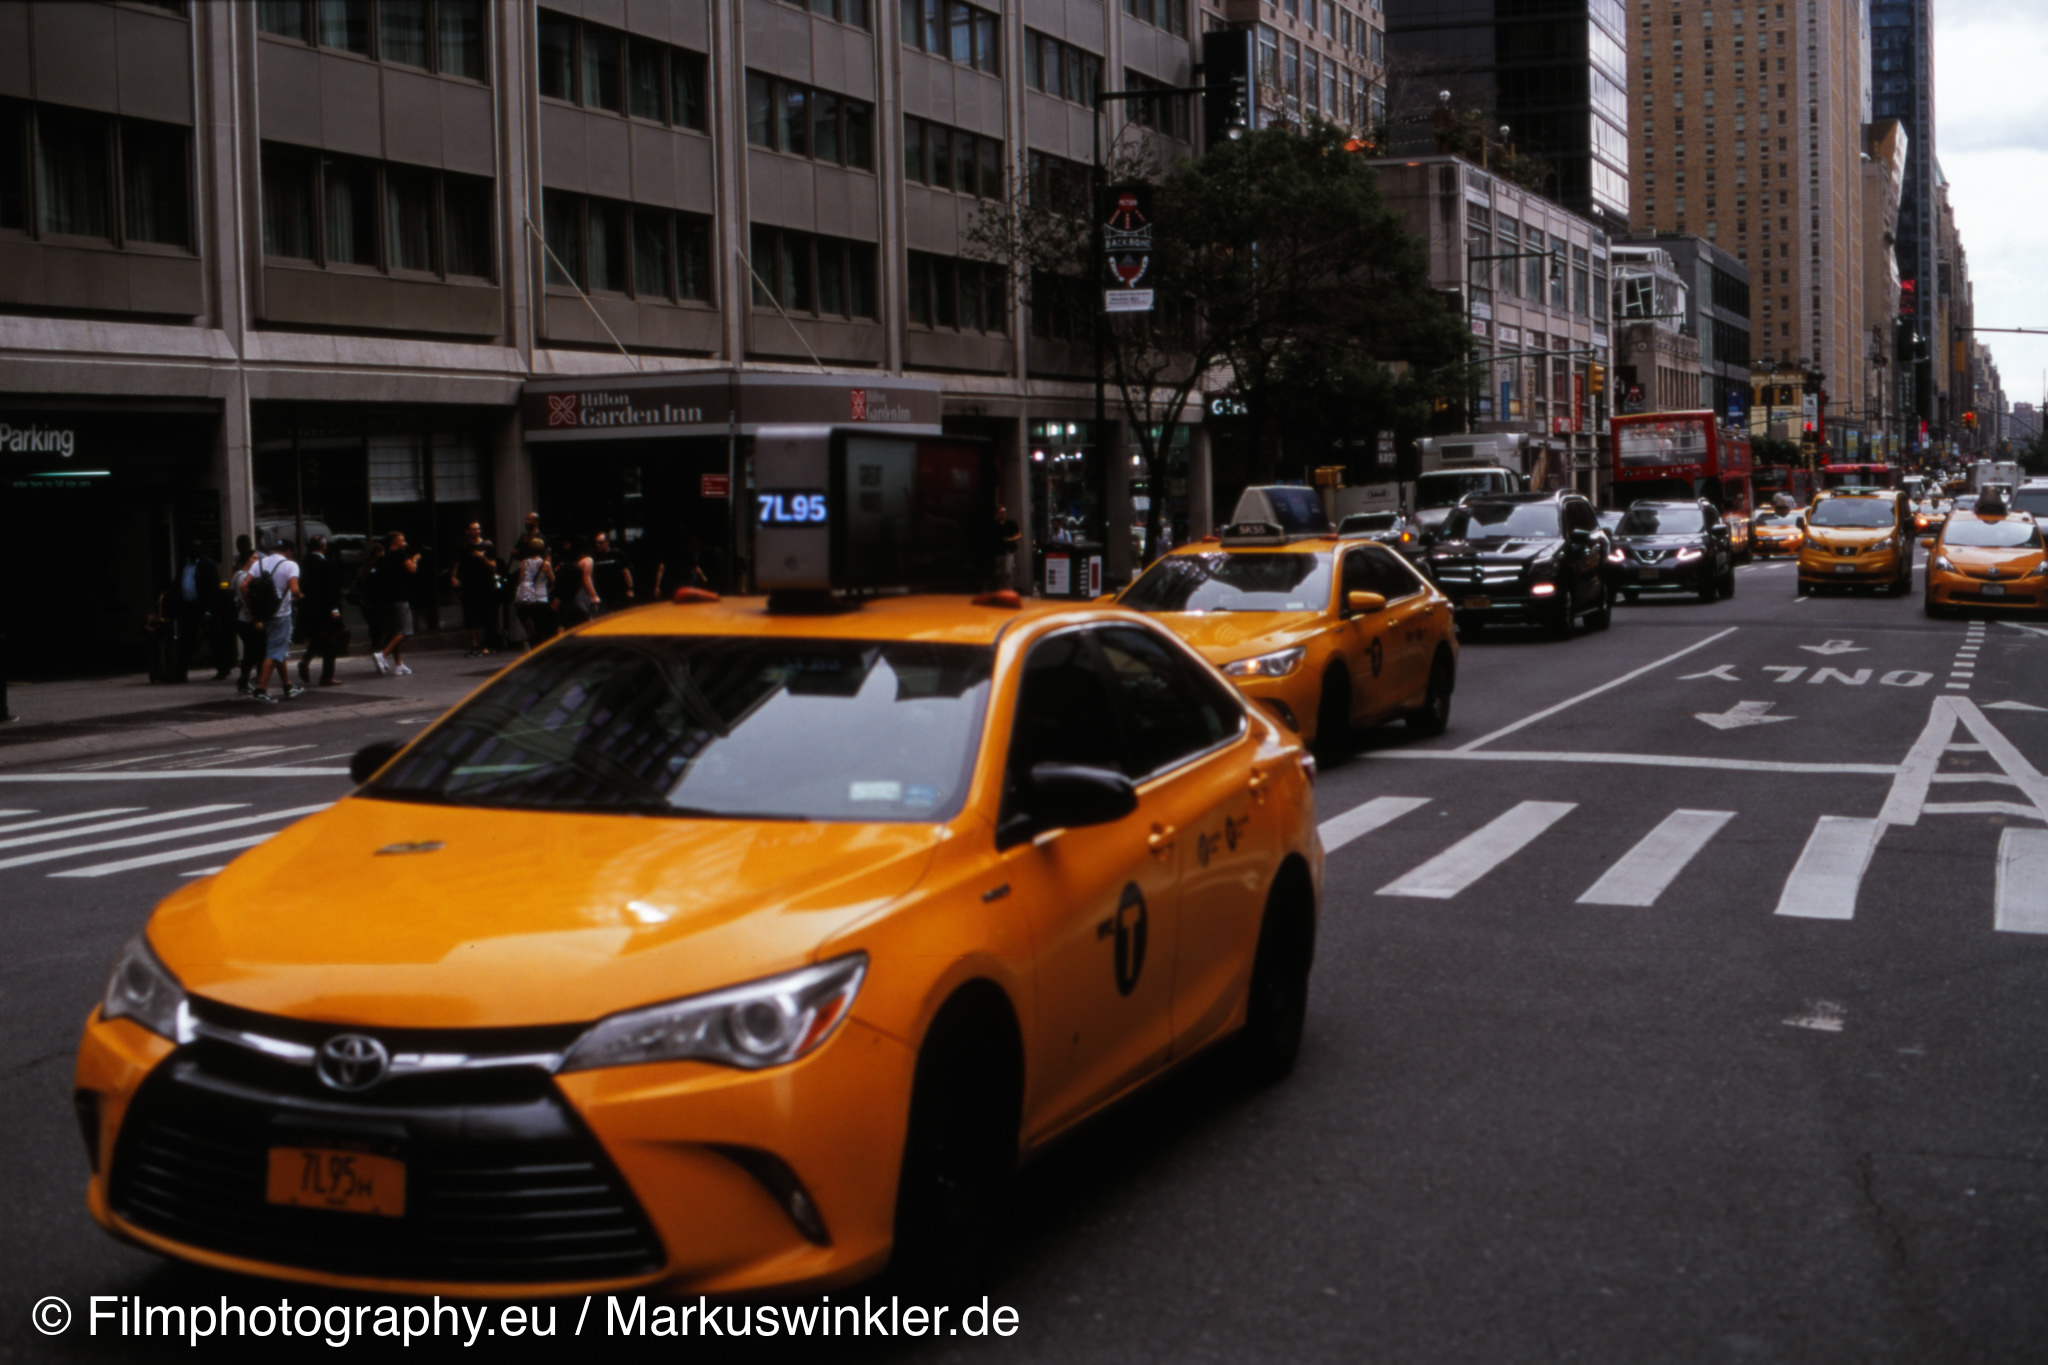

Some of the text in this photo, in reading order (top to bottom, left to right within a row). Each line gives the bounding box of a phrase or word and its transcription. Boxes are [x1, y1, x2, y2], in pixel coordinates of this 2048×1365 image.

[581, 392, 630, 406] Hilton
[580, 403, 703, 426] Garden Inn
[0, 422, 75, 457] Parking
[757, 494, 828, 522] 7L95
[1676, 664, 1934, 687] ONLY
